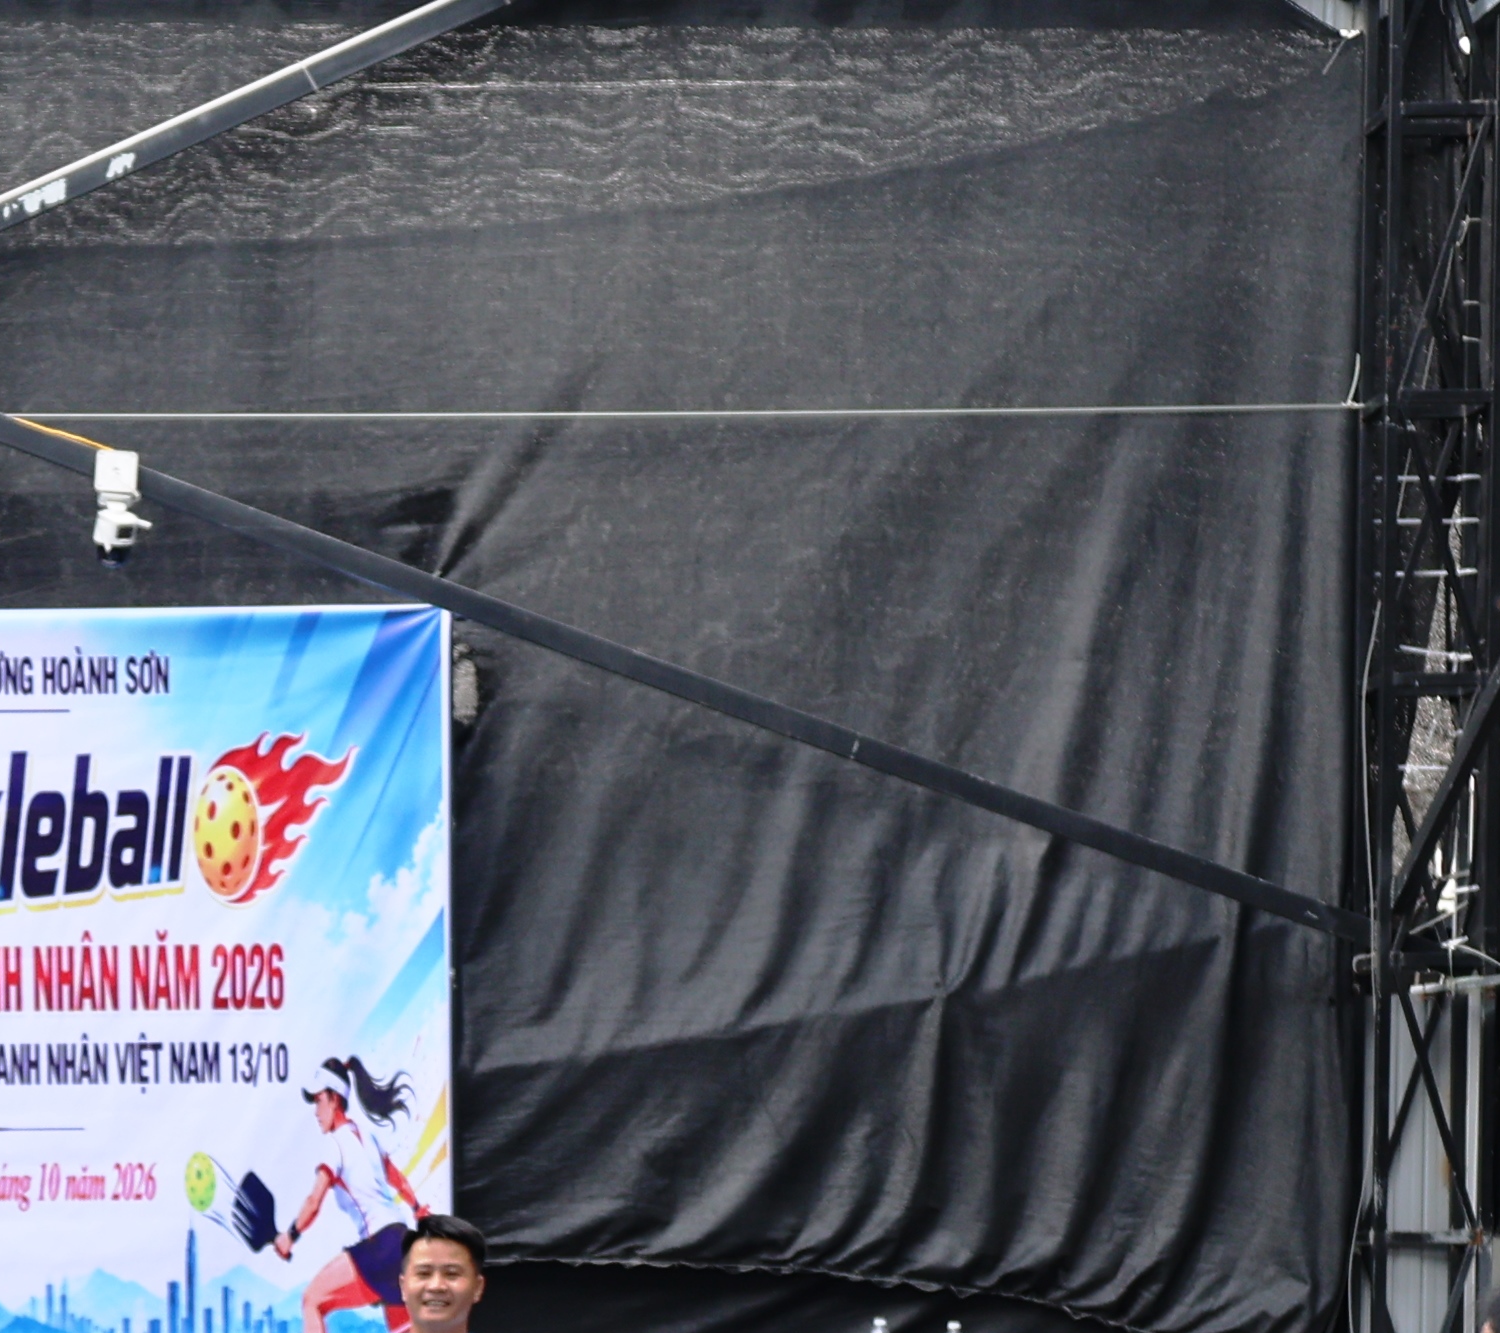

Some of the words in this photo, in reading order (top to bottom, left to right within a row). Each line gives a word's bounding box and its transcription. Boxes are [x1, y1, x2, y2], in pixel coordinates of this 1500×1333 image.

[42, 646, 118, 695] HOÀNH
[126, 649, 169, 695] SƠN
[33, 930, 119, 1012] NHÂN
[131, 929, 200, 1010] NĂM
[211, 943, 285, 1010] 2026
[47, 1033, 108, 1085] NHÂN
[115, 1032, 163, 1094] VIỆT
[170, 1041, 220, 1084] NAM
[227, 1042, 289, 1087] 13/10
[38, 1162, 61, 1201] 10
[65, 1164, 105, 1201] năm
[111, 1162, 158, 1201] 2026
